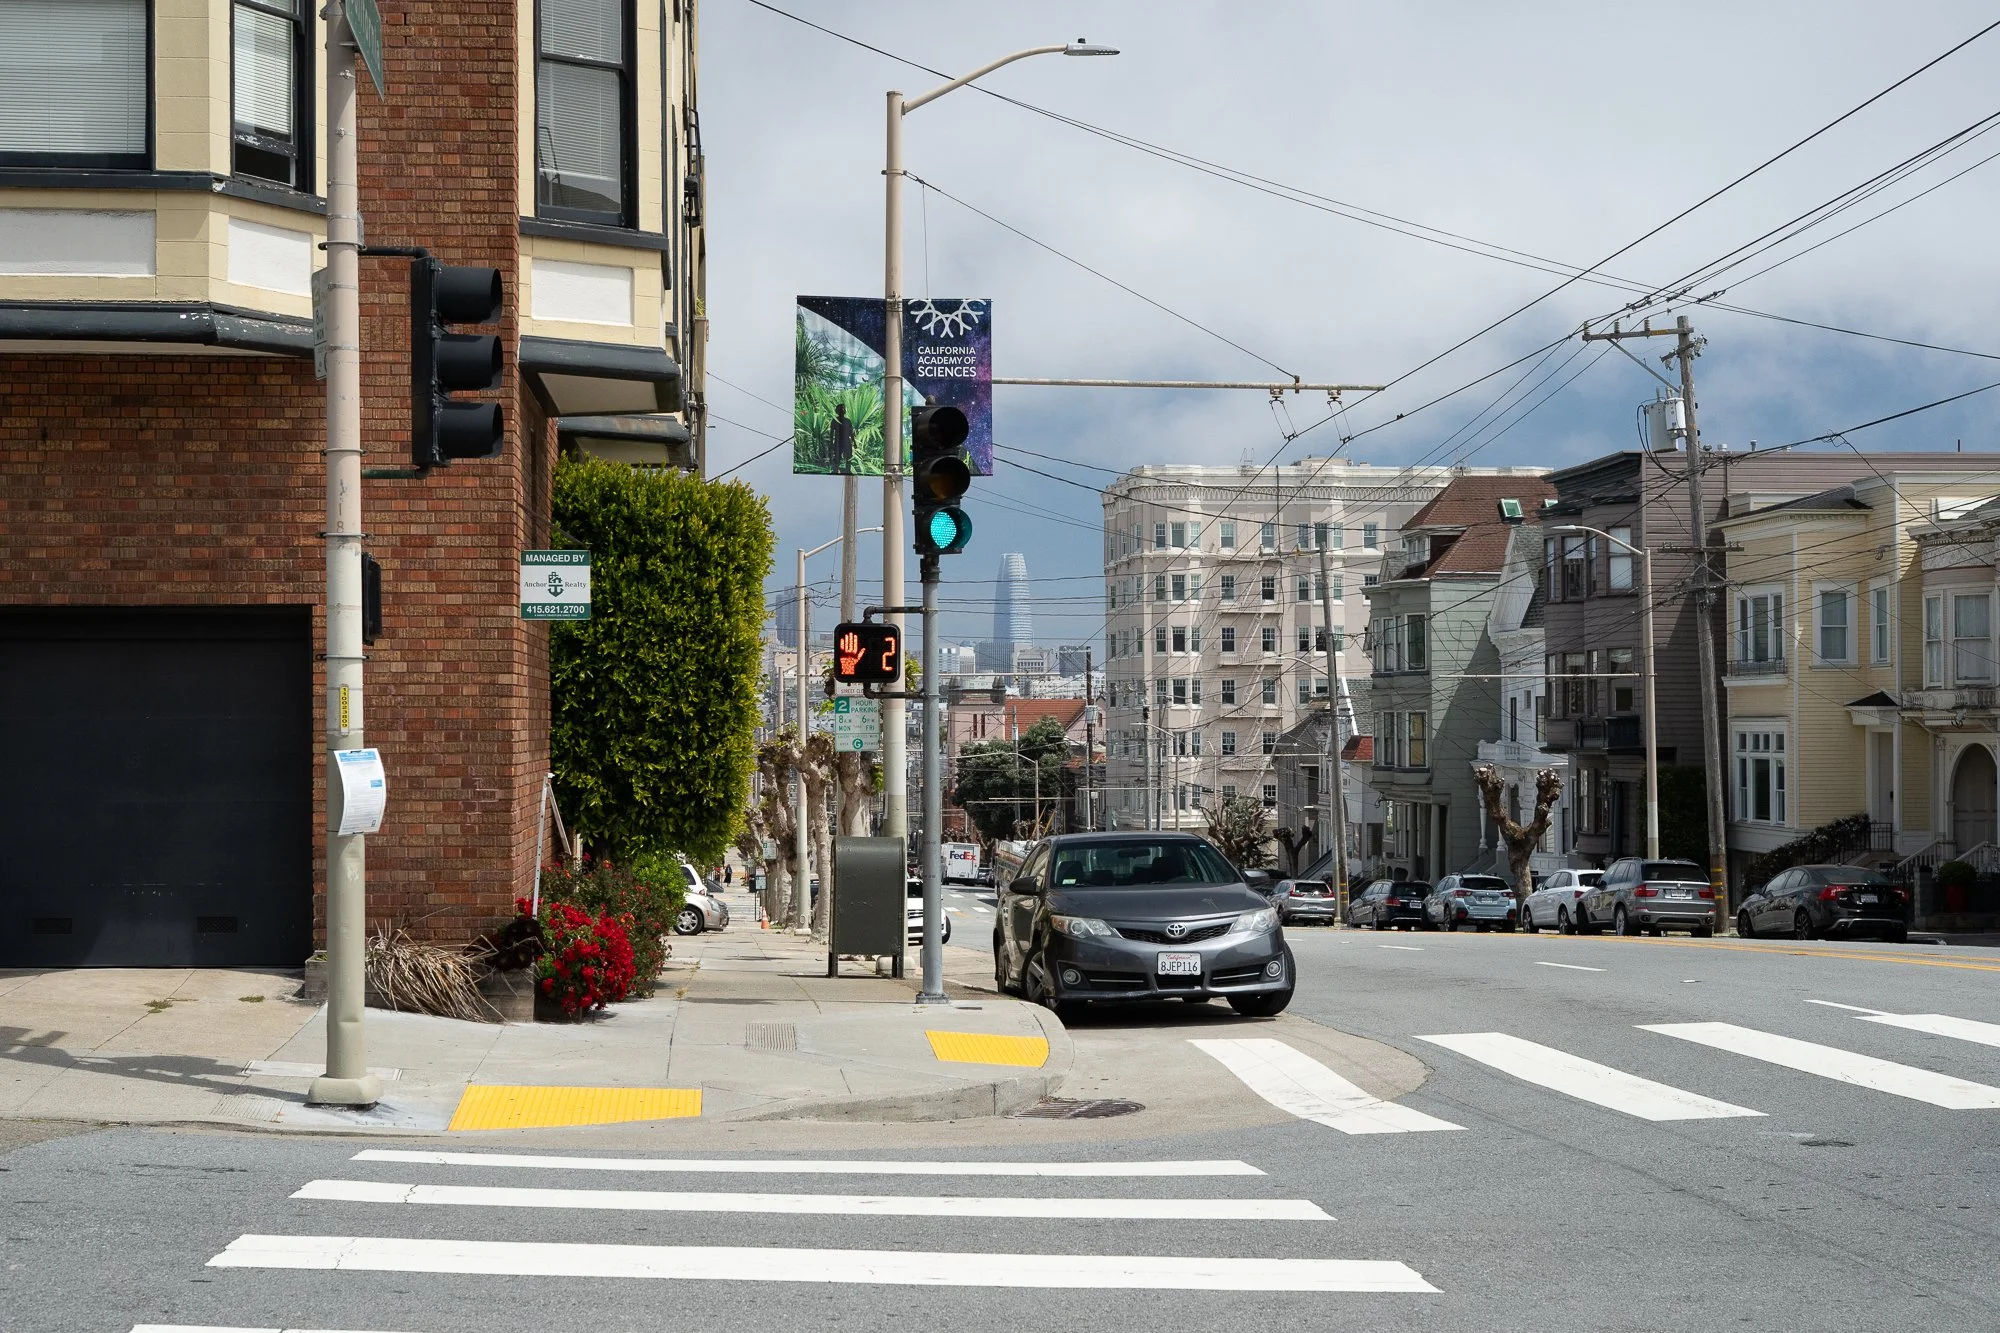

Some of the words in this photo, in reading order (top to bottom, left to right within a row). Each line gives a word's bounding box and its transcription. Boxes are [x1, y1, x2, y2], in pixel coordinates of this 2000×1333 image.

[918, 346, 976, 355] CALIFORNIA
[918, 356, 963, 365] ACADEMY
[964, 356, 976, 365] OF
[918, 366, 976, 378] SCIENCES
[526, 606, 585, 614] 415.621.2700
[882, 636, 896, 671] 2
[838, 700, 848, 711] 2
[854, 740, 861, 748] G
[949, 851, 976, 861] FedEx
[1161, 961, 1198, 972] 8JEP116
